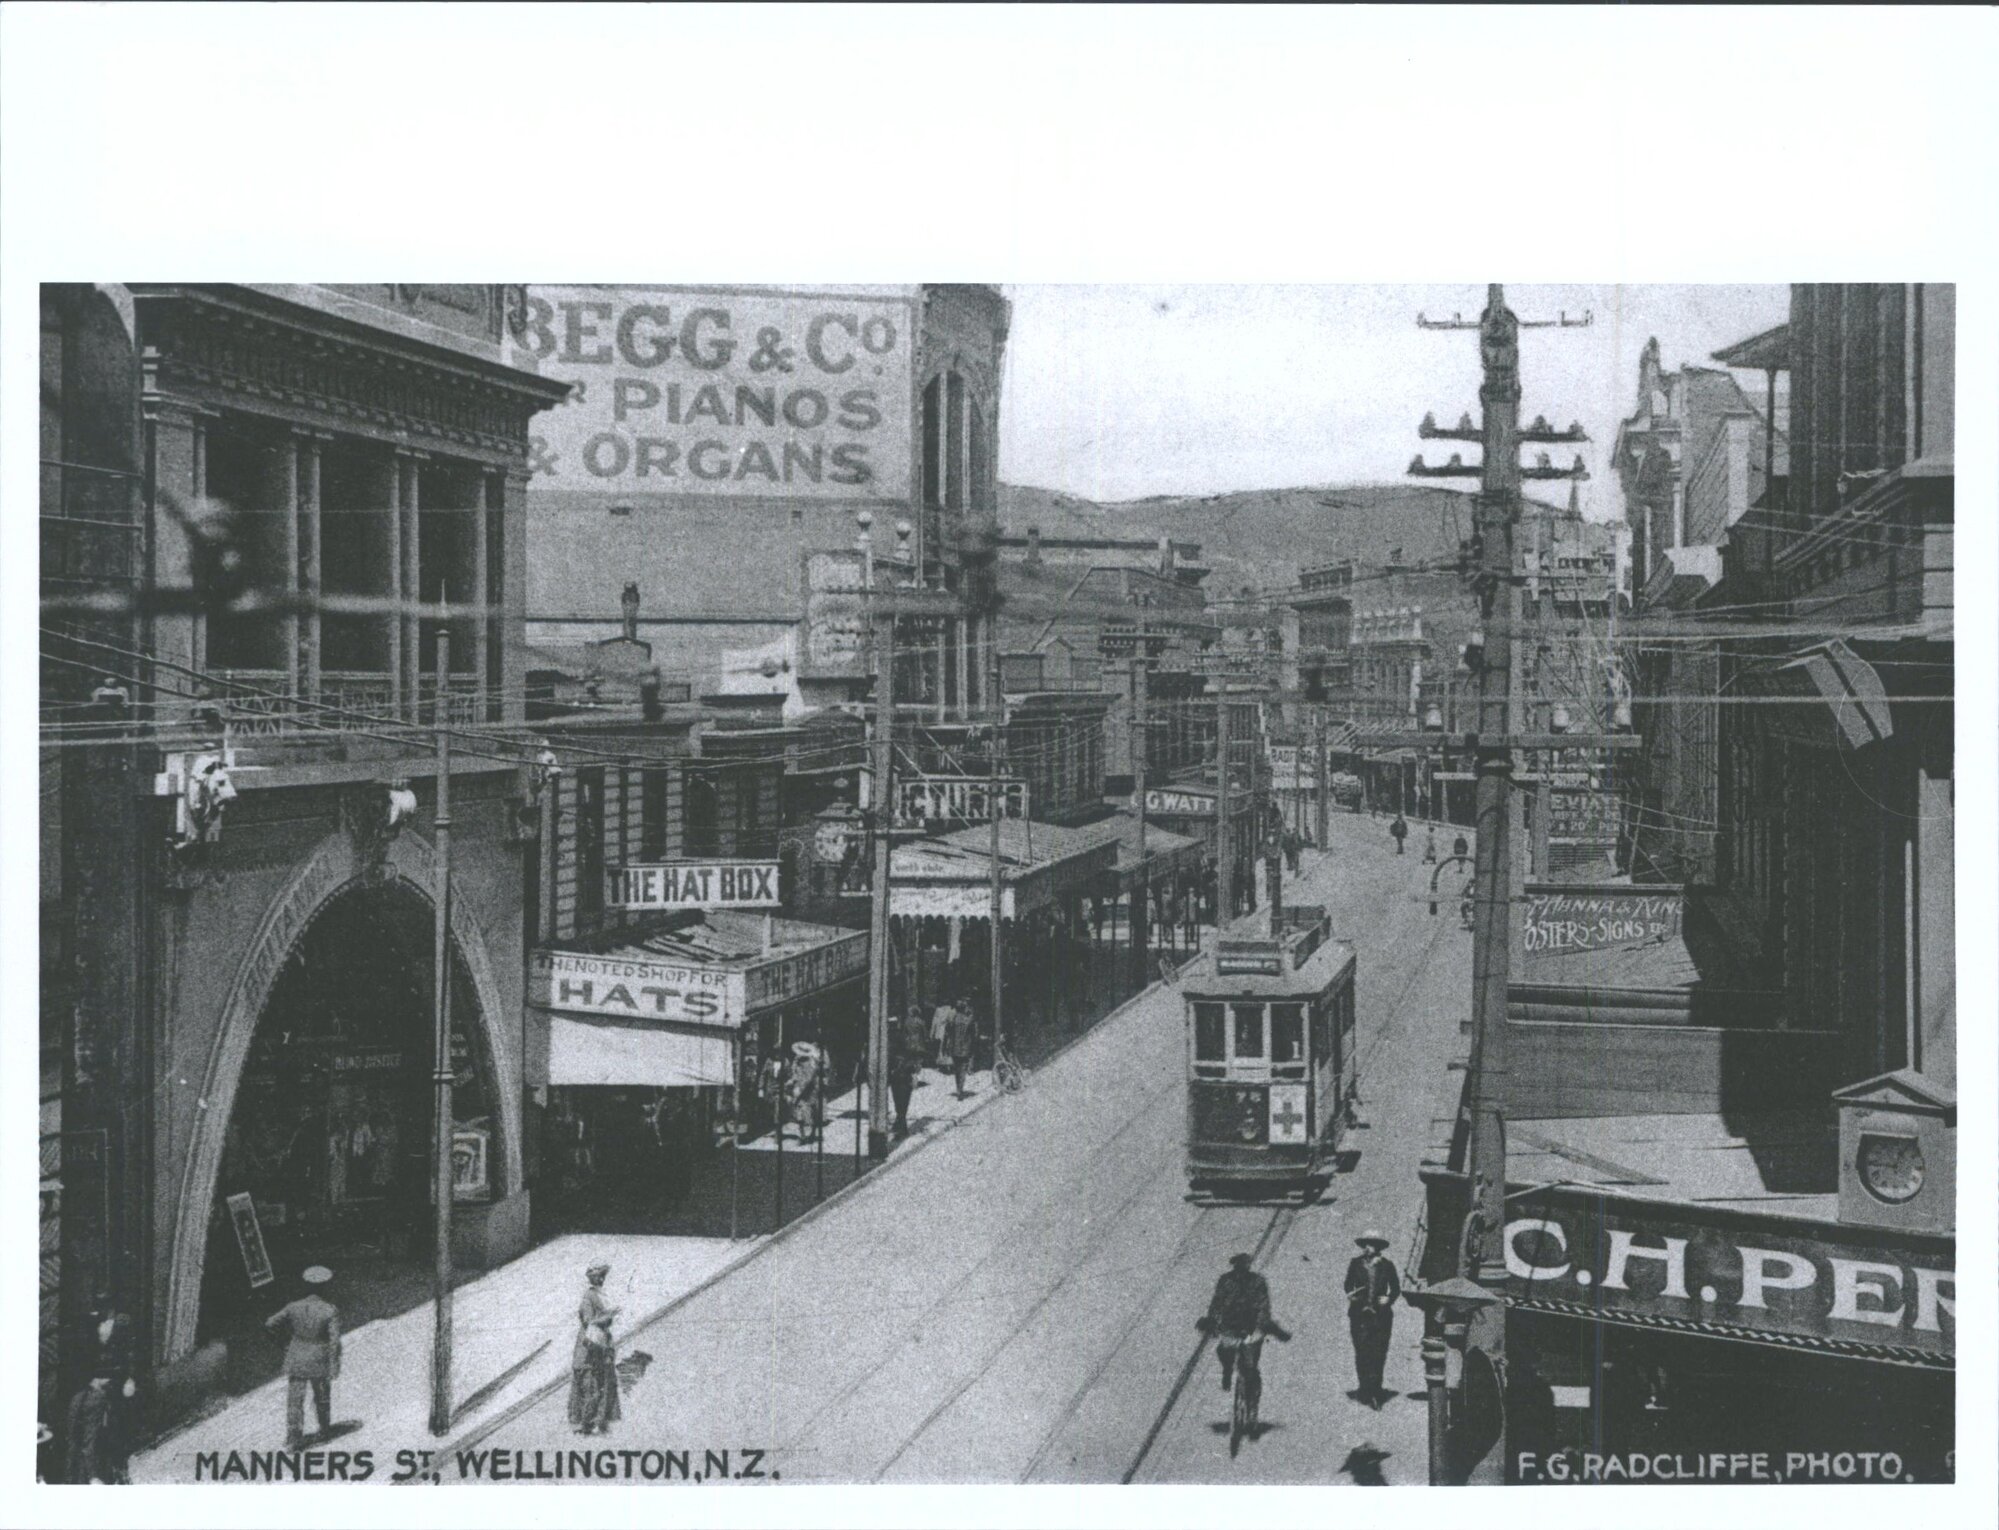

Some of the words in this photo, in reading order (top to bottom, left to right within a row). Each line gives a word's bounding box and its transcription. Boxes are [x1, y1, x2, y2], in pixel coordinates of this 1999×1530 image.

[508, 297, 738, 370] BEGG
[748, 326, 795, 372] &
[613, 377, 882, 432] PIANOS
[582, 431, 873, 485] ORGANS
[606, 868, 657, 904] THE
[663, 868, 714, 902] HAT
[720, 867, 774, 901] BOX
[637, 963, 687, 983] SHOP
